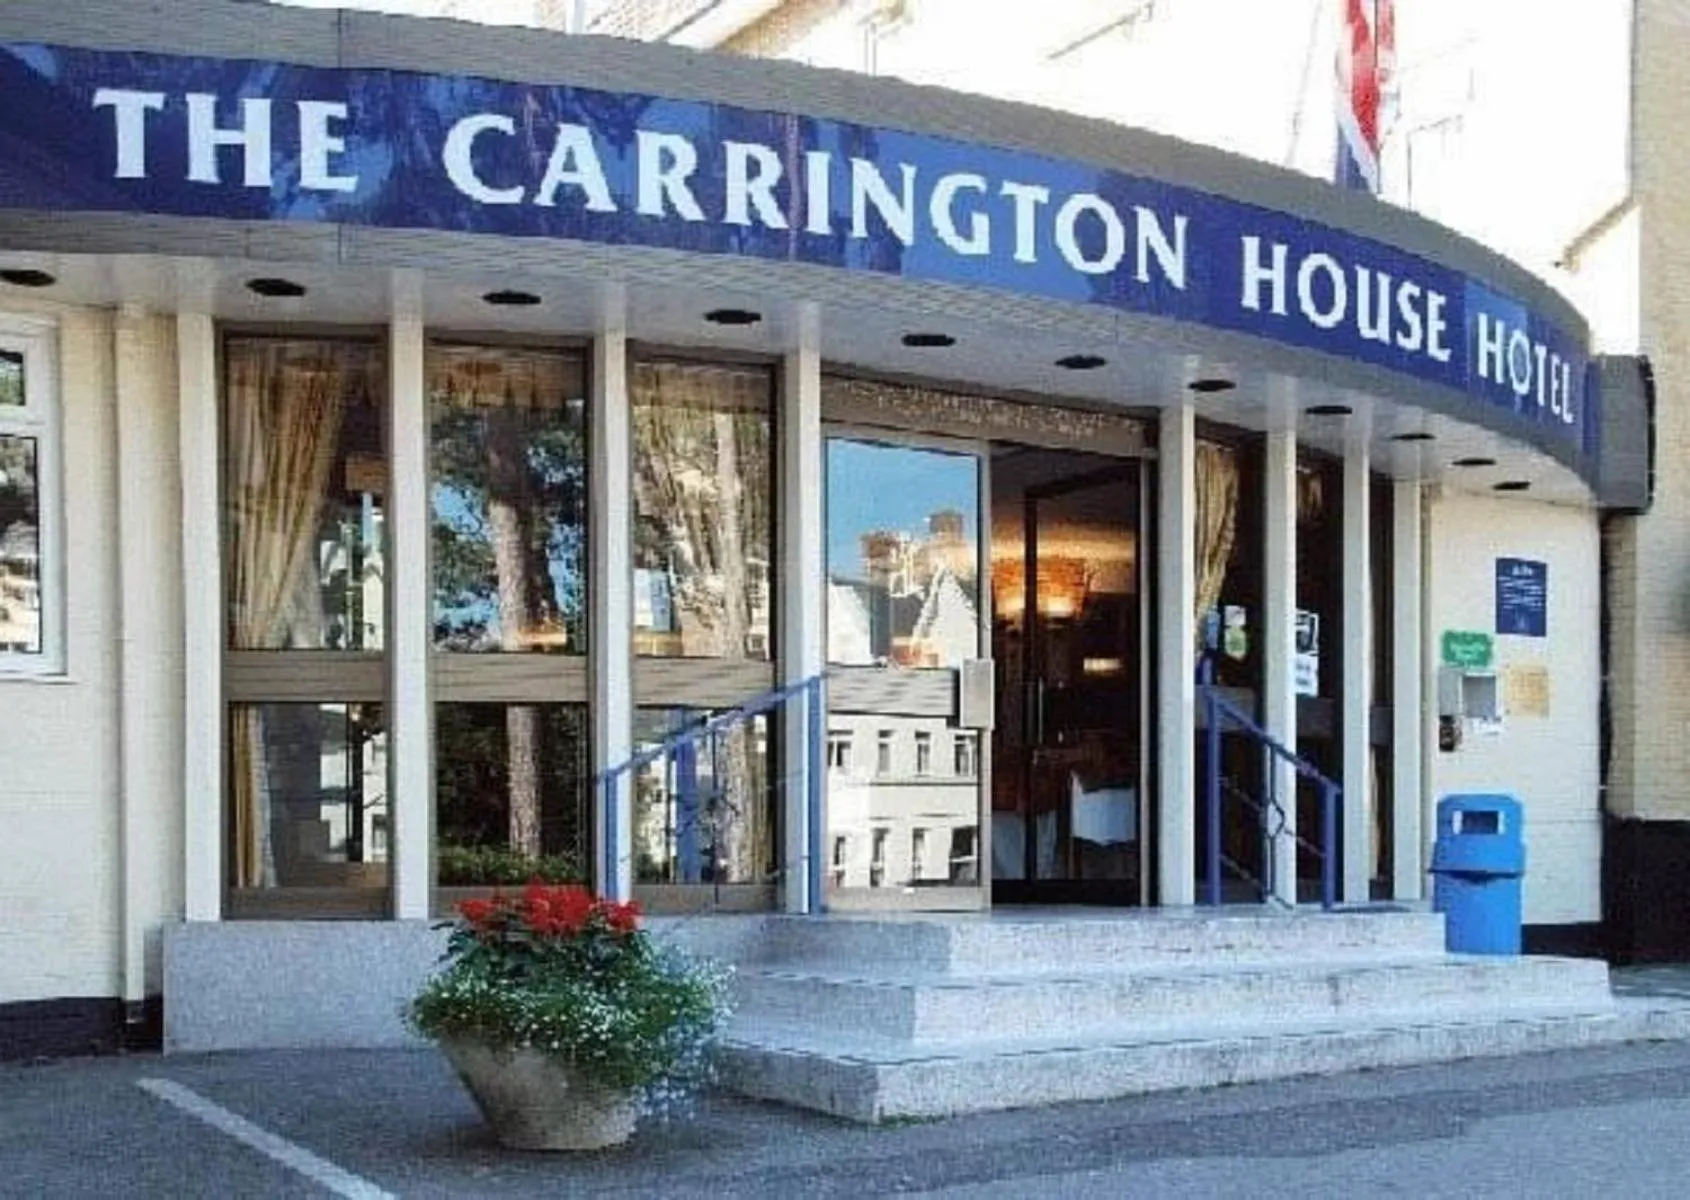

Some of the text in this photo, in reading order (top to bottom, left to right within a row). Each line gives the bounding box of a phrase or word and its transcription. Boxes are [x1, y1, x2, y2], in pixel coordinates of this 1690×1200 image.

[93, 88, 1574, 423] THE CARRINGTON HOUSE HOTEL
